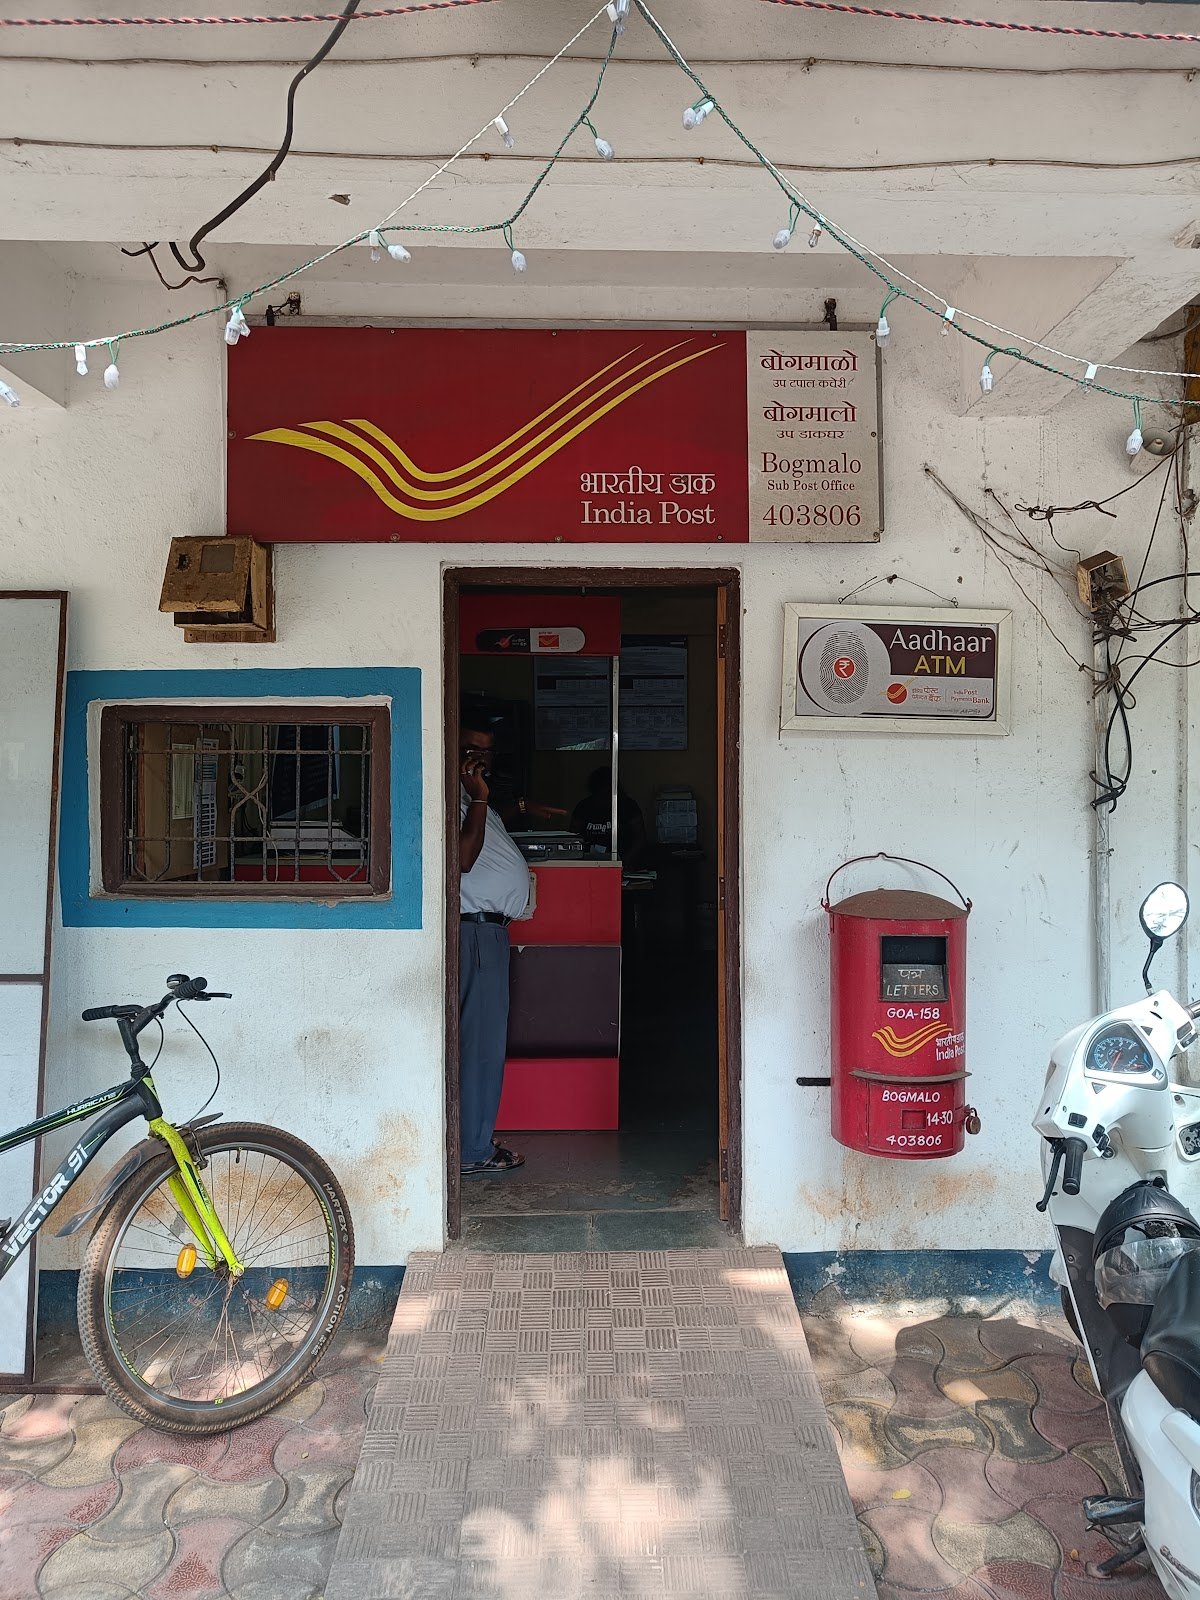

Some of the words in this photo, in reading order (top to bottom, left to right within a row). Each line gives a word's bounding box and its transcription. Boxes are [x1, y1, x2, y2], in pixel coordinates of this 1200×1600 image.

[760, 349, 858, 371] बोगमाळो
[773, 379, 787, 388] उप
[789, 379, 815, 388] टपाल
[763, 400, 857, 422] बोगमालो
[776, 430, 794, 439] उप
[798, 430, 845, 439] डाकघर
[761, 452, 862, 478] Bogmalo
[580, 465, 664, 495] भारतीय
[668, 473, 716, 495] डाक
[767, 479, 789, 491] Sub
[793, 479, 818, 491] Post
[821, 479, 855, 491] Office
[580, 501, 652, 524] India
[658, 502, 716, 524] Post
[762, 505, 861, 526] 403806
[889, 628, 992, 653] Aadhaar
[914, 655, 966, 675] ATM
[886, 984, 939, 997] LETTERS
[887, 1008, 940, 1020] GOA-158
[936, 1047, 954, 1061] India
[882, 1090, 940, 1103] BOGMALO
[927, 1111, 953, 1126] 14-30
[886, 1135, 942, 1146] 403806
[2, 1172, 71, 1257] VECTOR
[323, 1182, 348, 1232] HARTEX
[325, 1285, 346, 1332] ACTION
